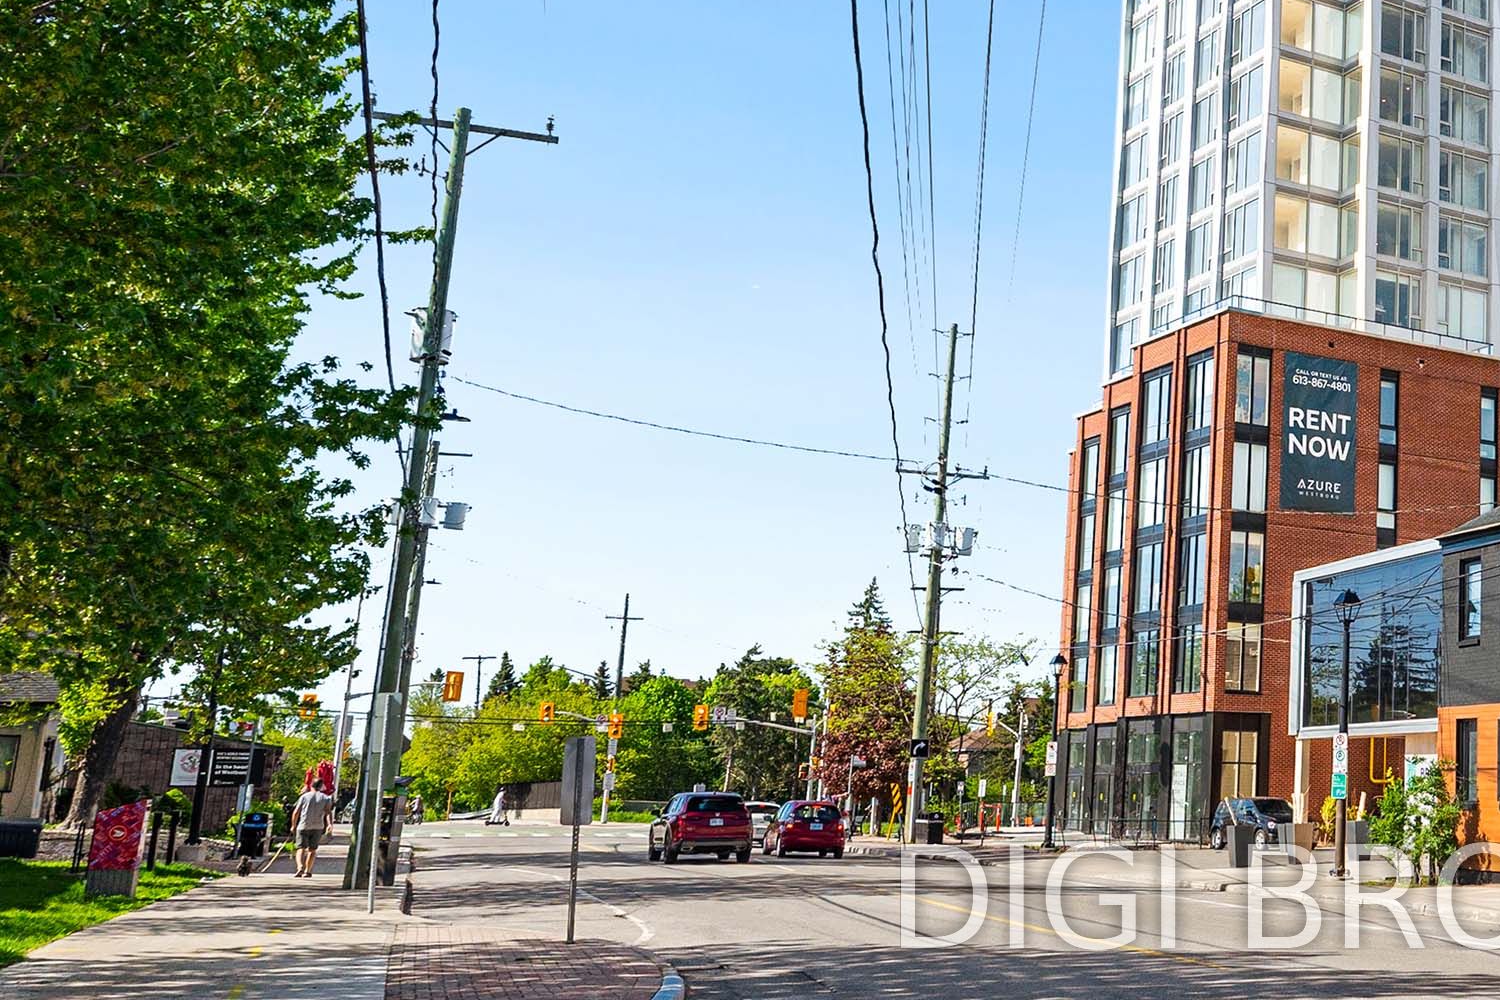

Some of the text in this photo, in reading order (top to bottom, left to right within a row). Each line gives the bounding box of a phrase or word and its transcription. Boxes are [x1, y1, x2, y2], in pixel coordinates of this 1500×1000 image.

[1295, 368, 1310, 376] CALL
[1293, 375, 1351, 392] 613-867-4801
[1289, 407, 1352, 434] RENT
[1288, 433, 1351, 461] NOW
[1297, 478, 1341, 493] AZURE
